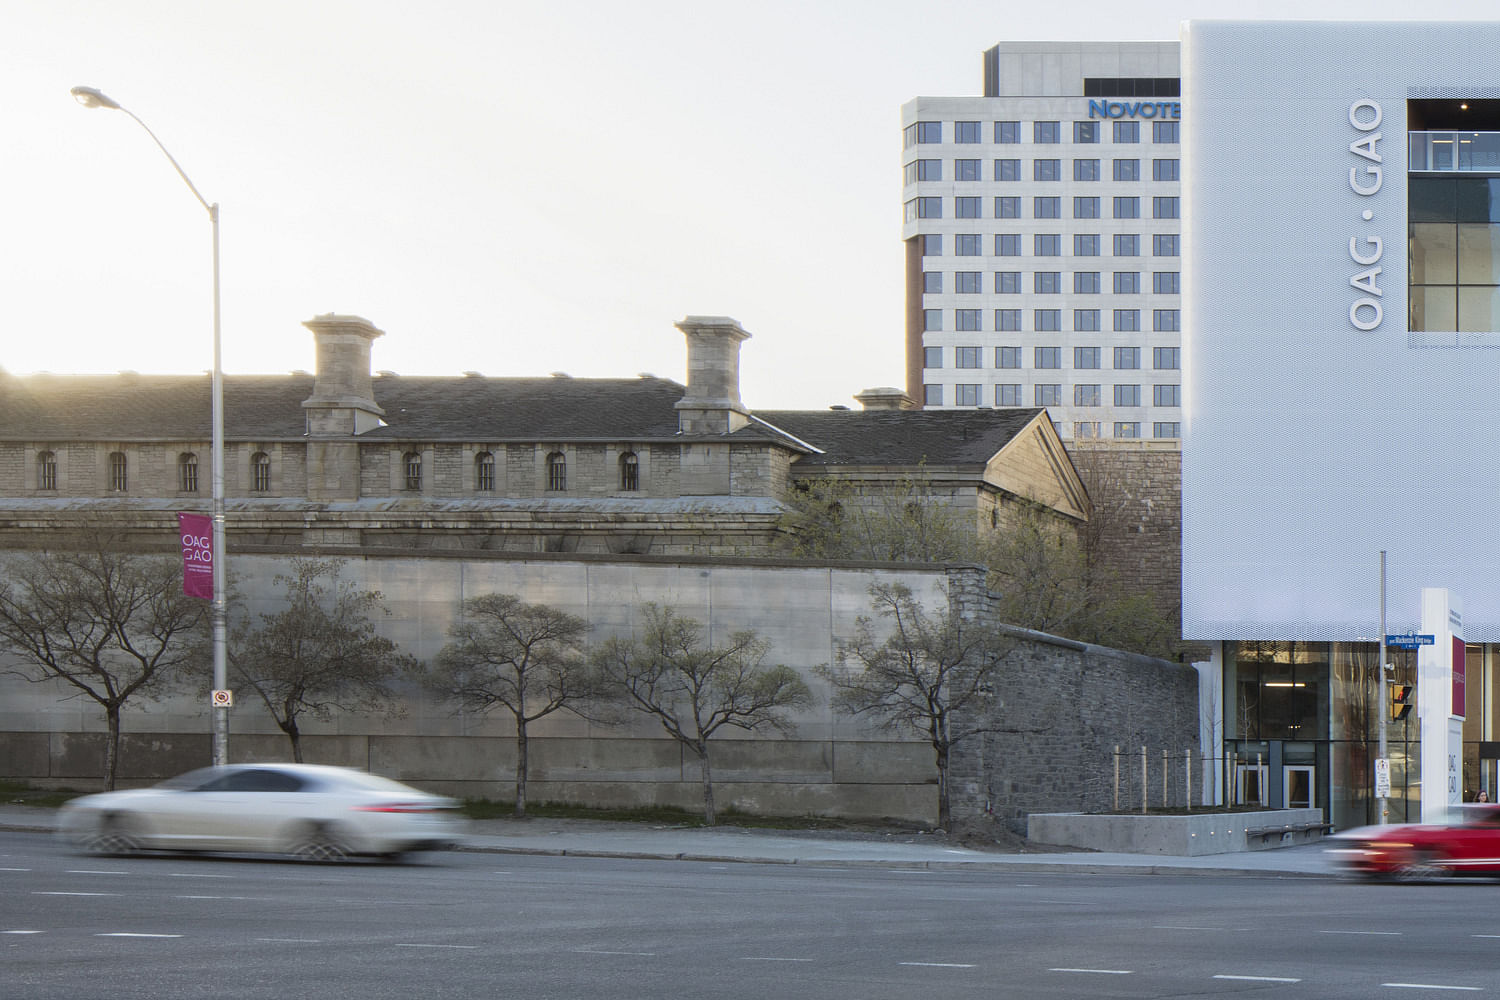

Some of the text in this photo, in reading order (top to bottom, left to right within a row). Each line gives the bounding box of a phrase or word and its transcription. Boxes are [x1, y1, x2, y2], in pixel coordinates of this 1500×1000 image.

[1349, 98, 1383, 331] OAG GAO
[182, 534, 210, 549] OAG
